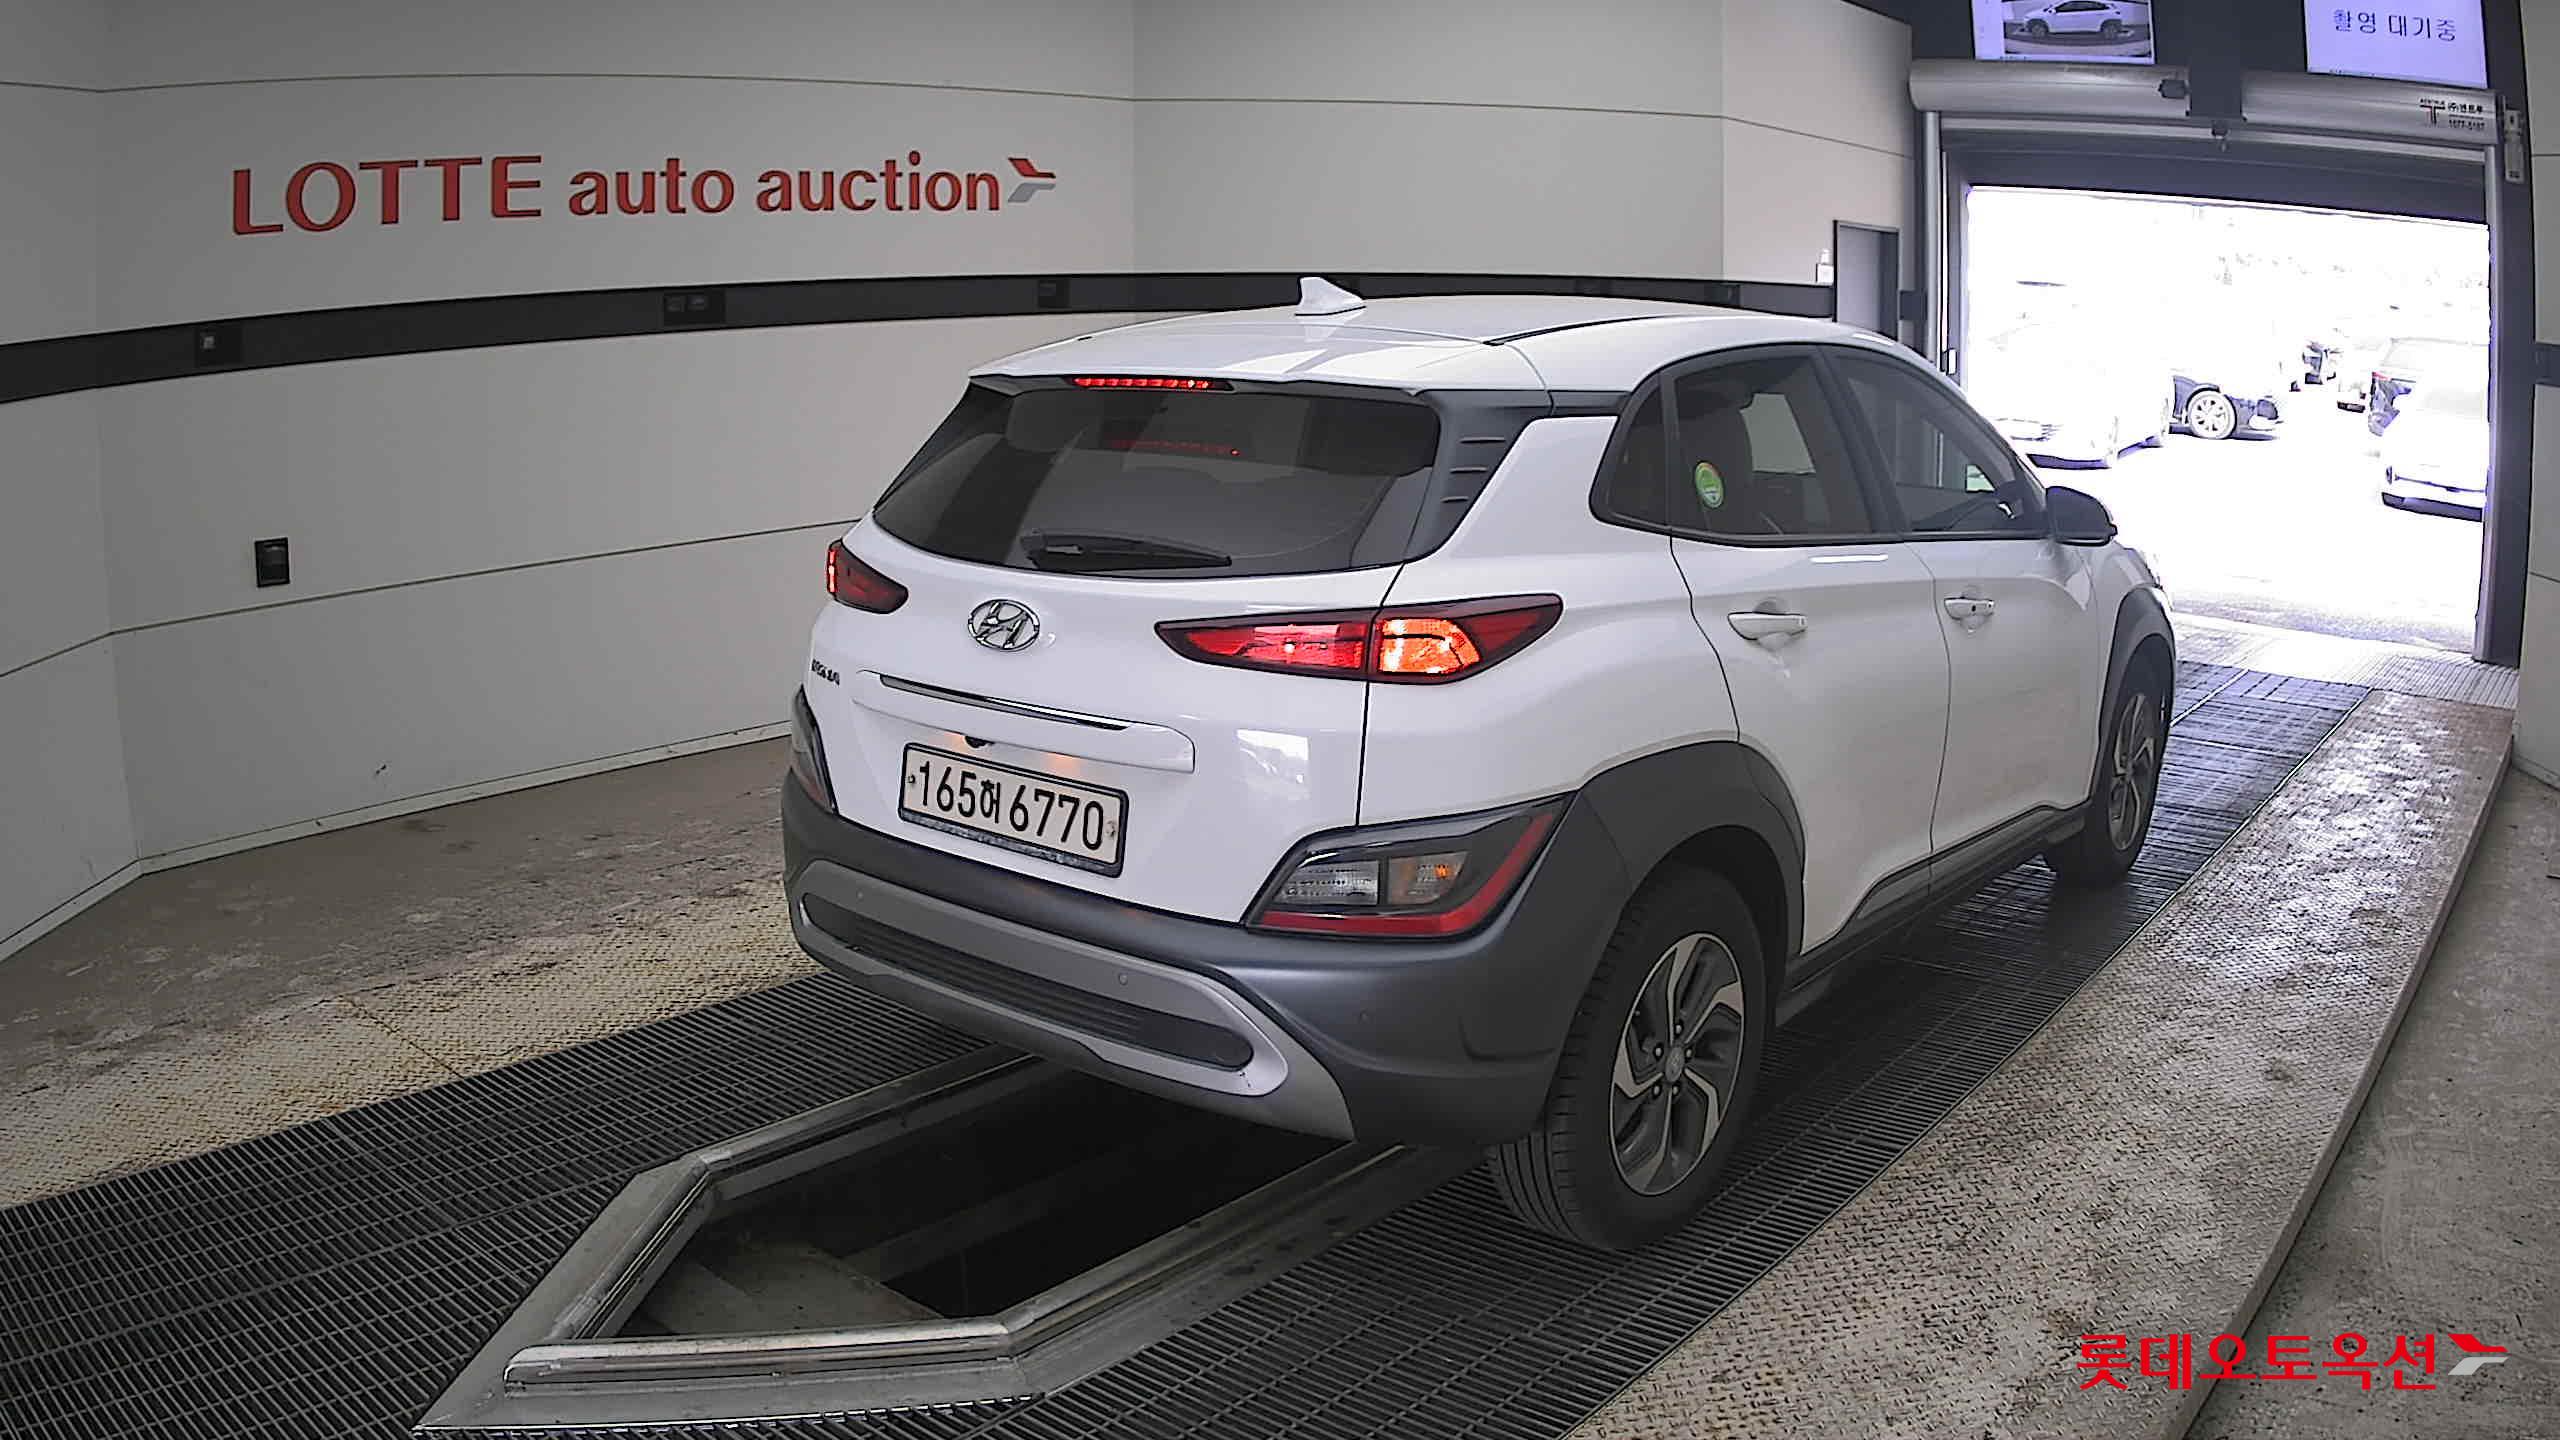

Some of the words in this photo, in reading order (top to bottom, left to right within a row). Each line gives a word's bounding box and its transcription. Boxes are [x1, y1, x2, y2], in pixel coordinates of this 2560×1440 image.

[2333, 9, 2376, 34] 촬영
[2388, 14, 2456, 42] 대기중
[232, 154, 543, 235] LOTTE
[567, 157, 735, 217] auto
[756, 149, 1001, 213] auction
